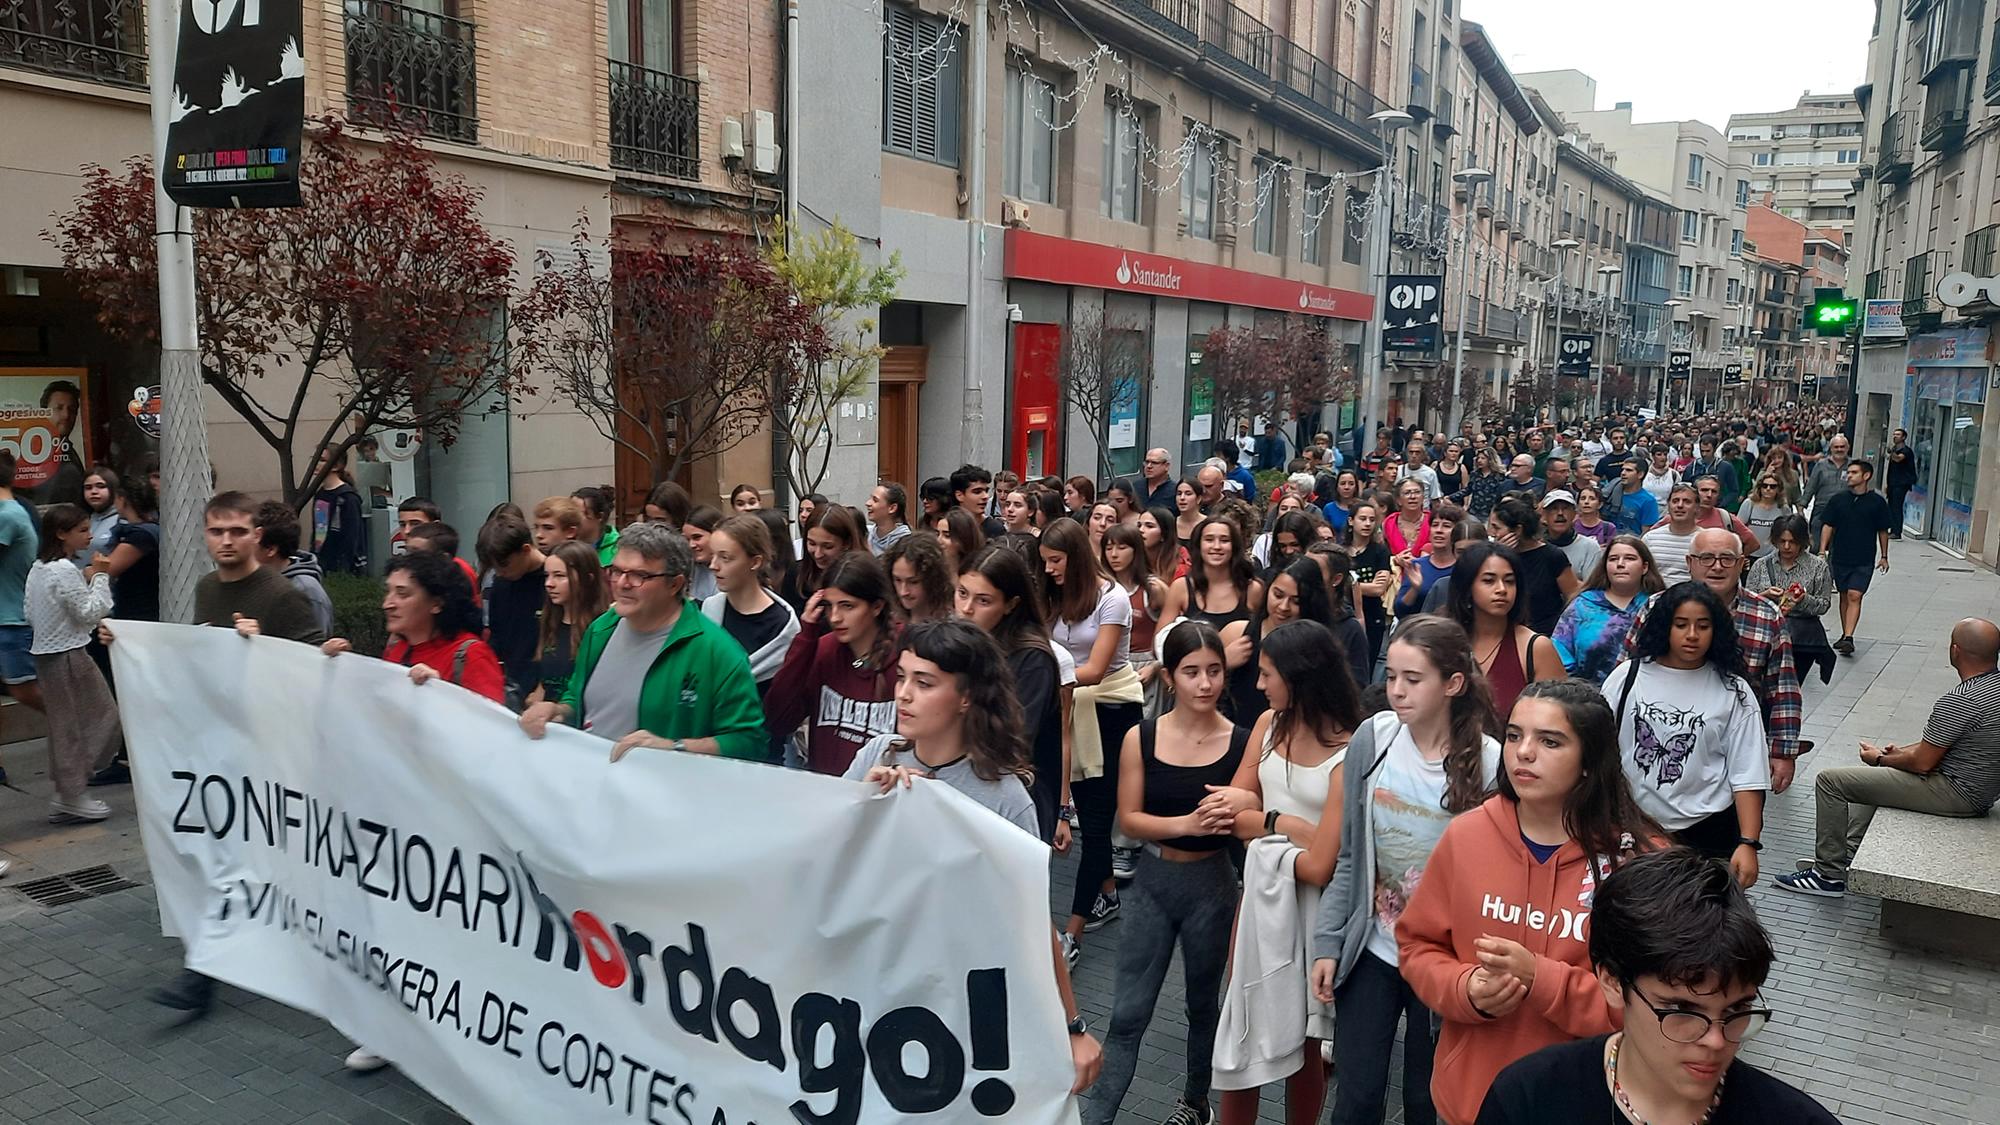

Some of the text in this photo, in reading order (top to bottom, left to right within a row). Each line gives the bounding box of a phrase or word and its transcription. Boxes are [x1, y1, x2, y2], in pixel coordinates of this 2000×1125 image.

[1132, 261, 1181, 290] Santander
[1308, 290, 1336, 311] Santander
[1390, 285, 1436, 309] OP
[1563, 339, 1591, 354] OP
[1672, 356, 1690, 365] OP
[172, 771, 1015, 1125] ZONIFIKAZIOARI hordago!
[477, 991, 528, 1058] DE
[537, 1021, 697, 1125] CORTES
